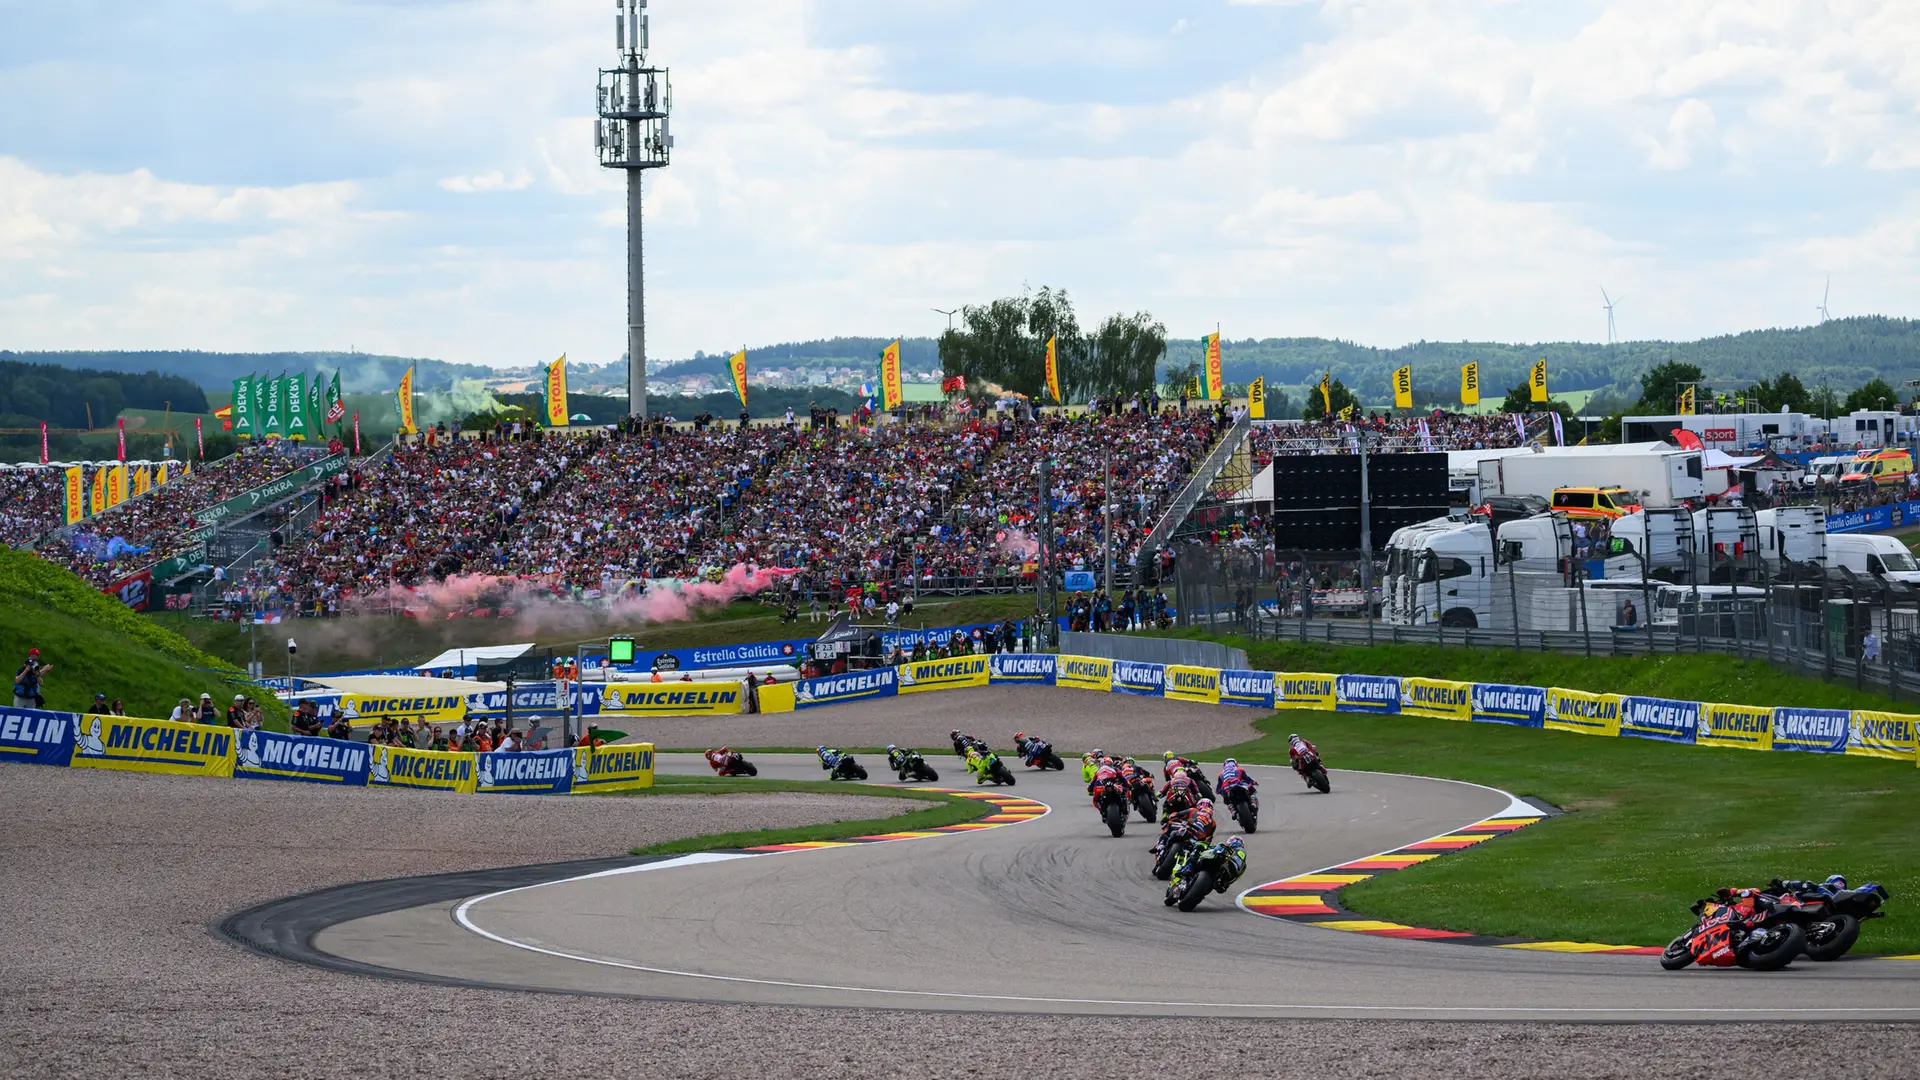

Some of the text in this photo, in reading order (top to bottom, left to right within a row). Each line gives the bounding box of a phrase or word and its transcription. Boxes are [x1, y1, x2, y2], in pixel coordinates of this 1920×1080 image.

[1705, 429, 1735, 440] sport
[263, 479, 294, 498] DEKRA
[693, 644, 779, 664] Estrella Galicia
[823, 644, 833, 652] 2.3
[916, 659, 986, 679] MICHELIN
[1002, 658, 1055, 673] MICHELIN
[1066, 660, 1109, 678] MICHELIN
[1121, 666, 1163, 685] MICHELIN
[813, 670, 893, 696] MICHELIN
[1174, 673, 1216, 690] MICHELIN
[1227, 676, 1273, 694] MICHELIN
[1283, 680, 1331, 697] MICHELIN
[1346, 682, 1397, 700] MICHELIN
[360, 696, 460, 713] MICHELIN
[625, 690, 737, 704] MICHELIN
[1414, 686, 1467, 706] MICHELIN
[1483, 691, 1541, 712] MICHELIN
[1558, 697, 1617, 720] MICHELIN
[1633, 703, 1695, 728] MICHELIN
[1712, 711, 1770, 733] MICHELIN
[1786, 714, 1845, 738] MICHELIN
[107, 724, 232, 757] MICHELIN
[262, 739, 365, 772] MICHELIN
[589, 750, 652, 774] MICHELIN
[391, 754, 473, 781] MICHELIN
[495, 756, 569, 780] MICHELIN
